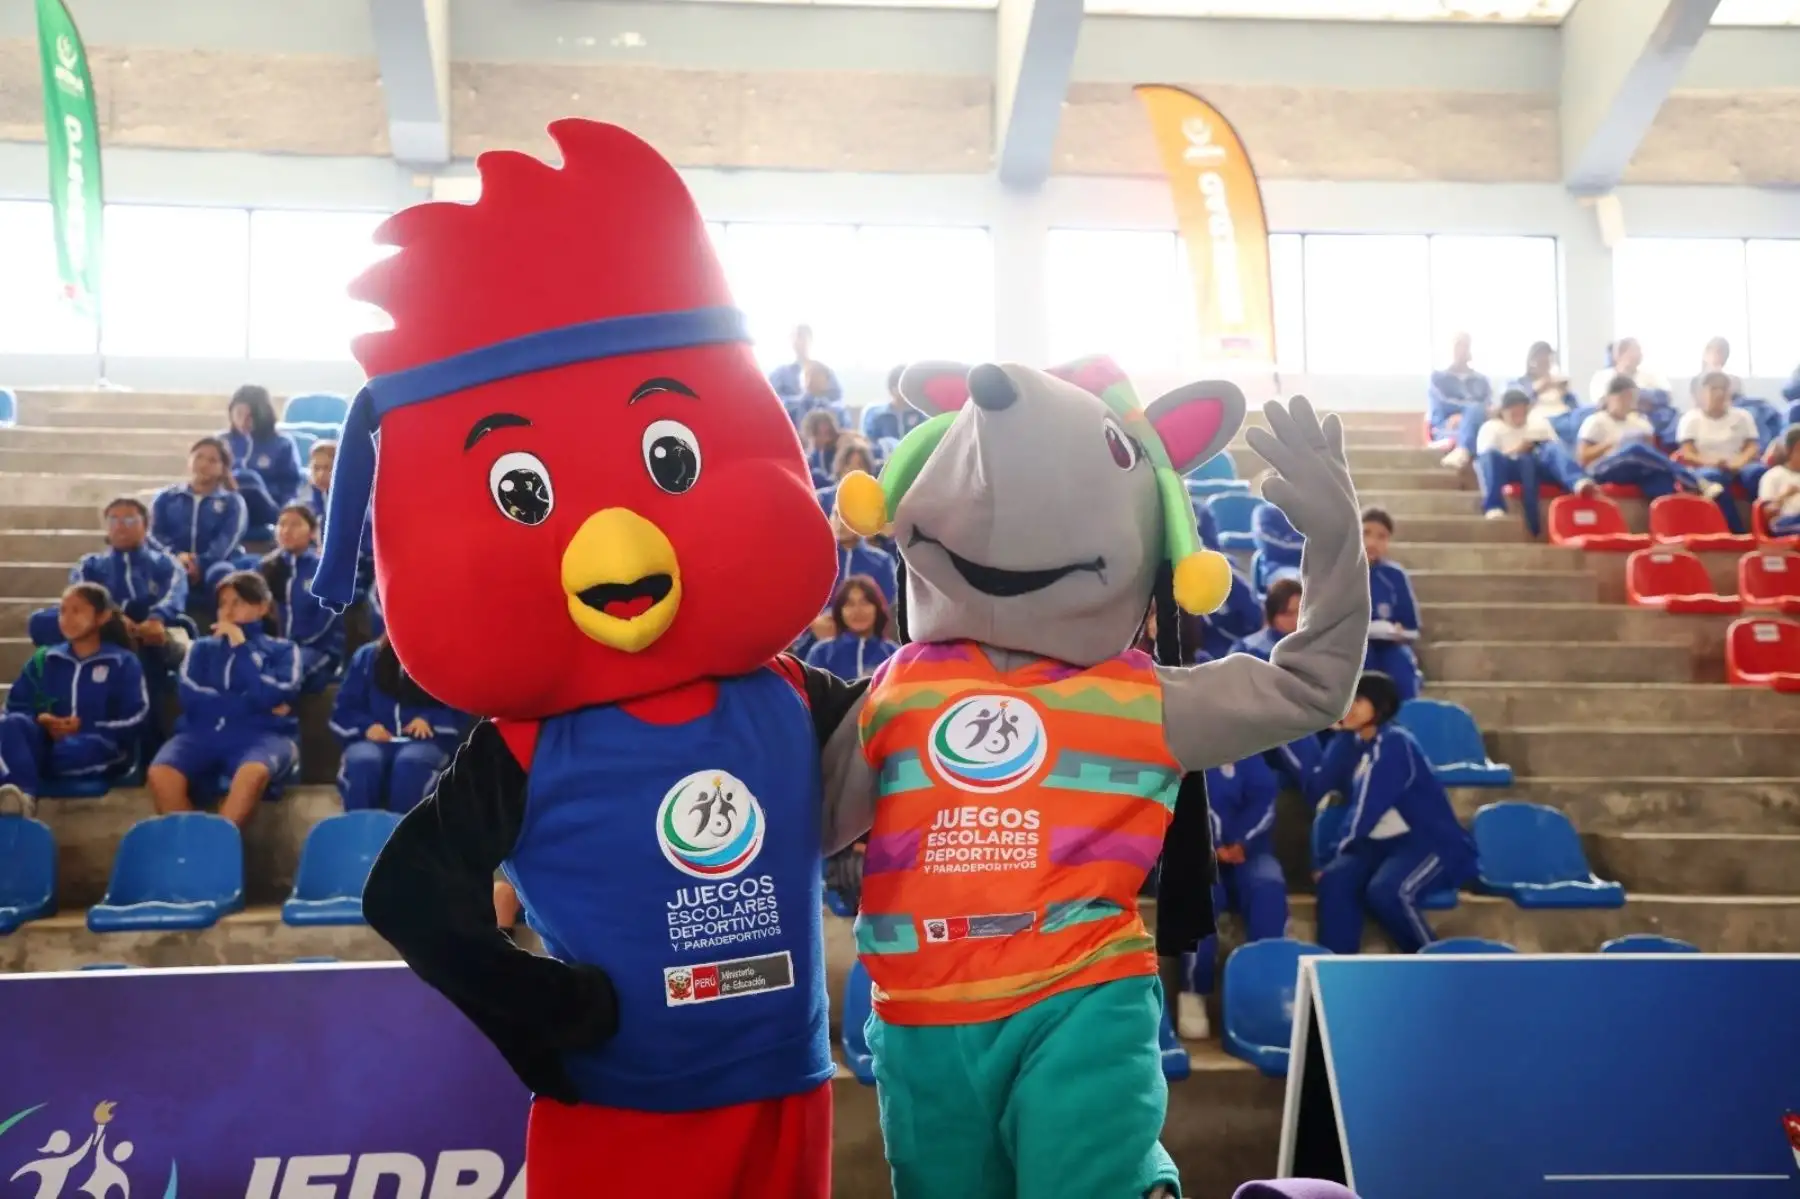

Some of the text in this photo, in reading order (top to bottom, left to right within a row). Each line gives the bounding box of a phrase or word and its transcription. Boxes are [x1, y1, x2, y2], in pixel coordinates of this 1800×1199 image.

[930, 806, 1040, 831] JUEGOS
[927, 830, 1039, 847] ESCOLARES
[925, 847, 1038, 862] DEPORTIVOS
[923, 860, 1037, 874] Y PARADEPORTIVOS
[667, 875, 774, 909] JUEGOS
[667, 895, 777, 925] ESCOLARES
[669, 911, 779, 940] DEPORTIVOS
[671, 925, 782, 952] Y PARADEPORTIVOS
[694, 974, 717, 989] PERÚ
[721, 966, 755, 981] Ministerio
[722, 975, 766, 991] de Educación
